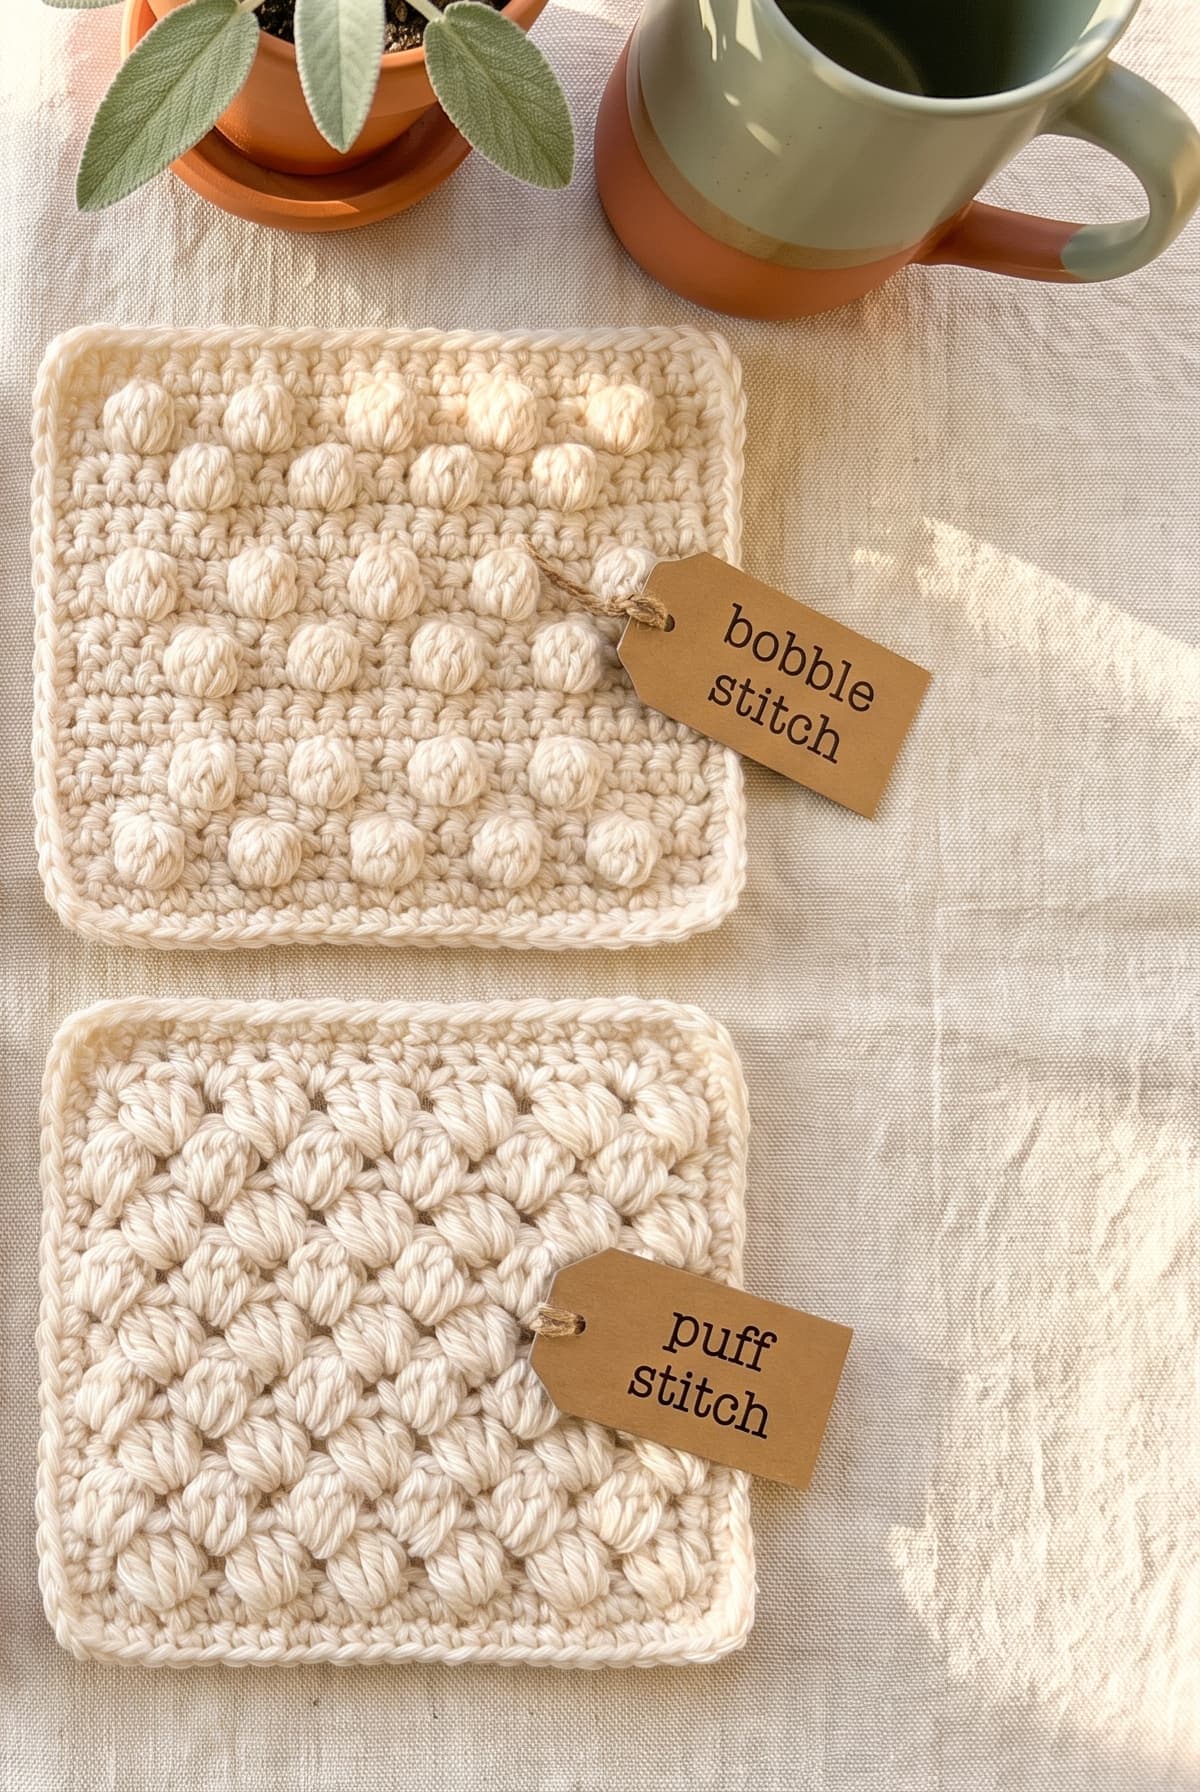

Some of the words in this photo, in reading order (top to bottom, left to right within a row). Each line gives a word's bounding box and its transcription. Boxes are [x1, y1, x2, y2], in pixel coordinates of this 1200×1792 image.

[723, 602, 875, 713] bobble
[707, 674, 840, 765] stitch
[661, 1311, 778, 1373] puff
[627, 1364, 769, 1440] stitch
